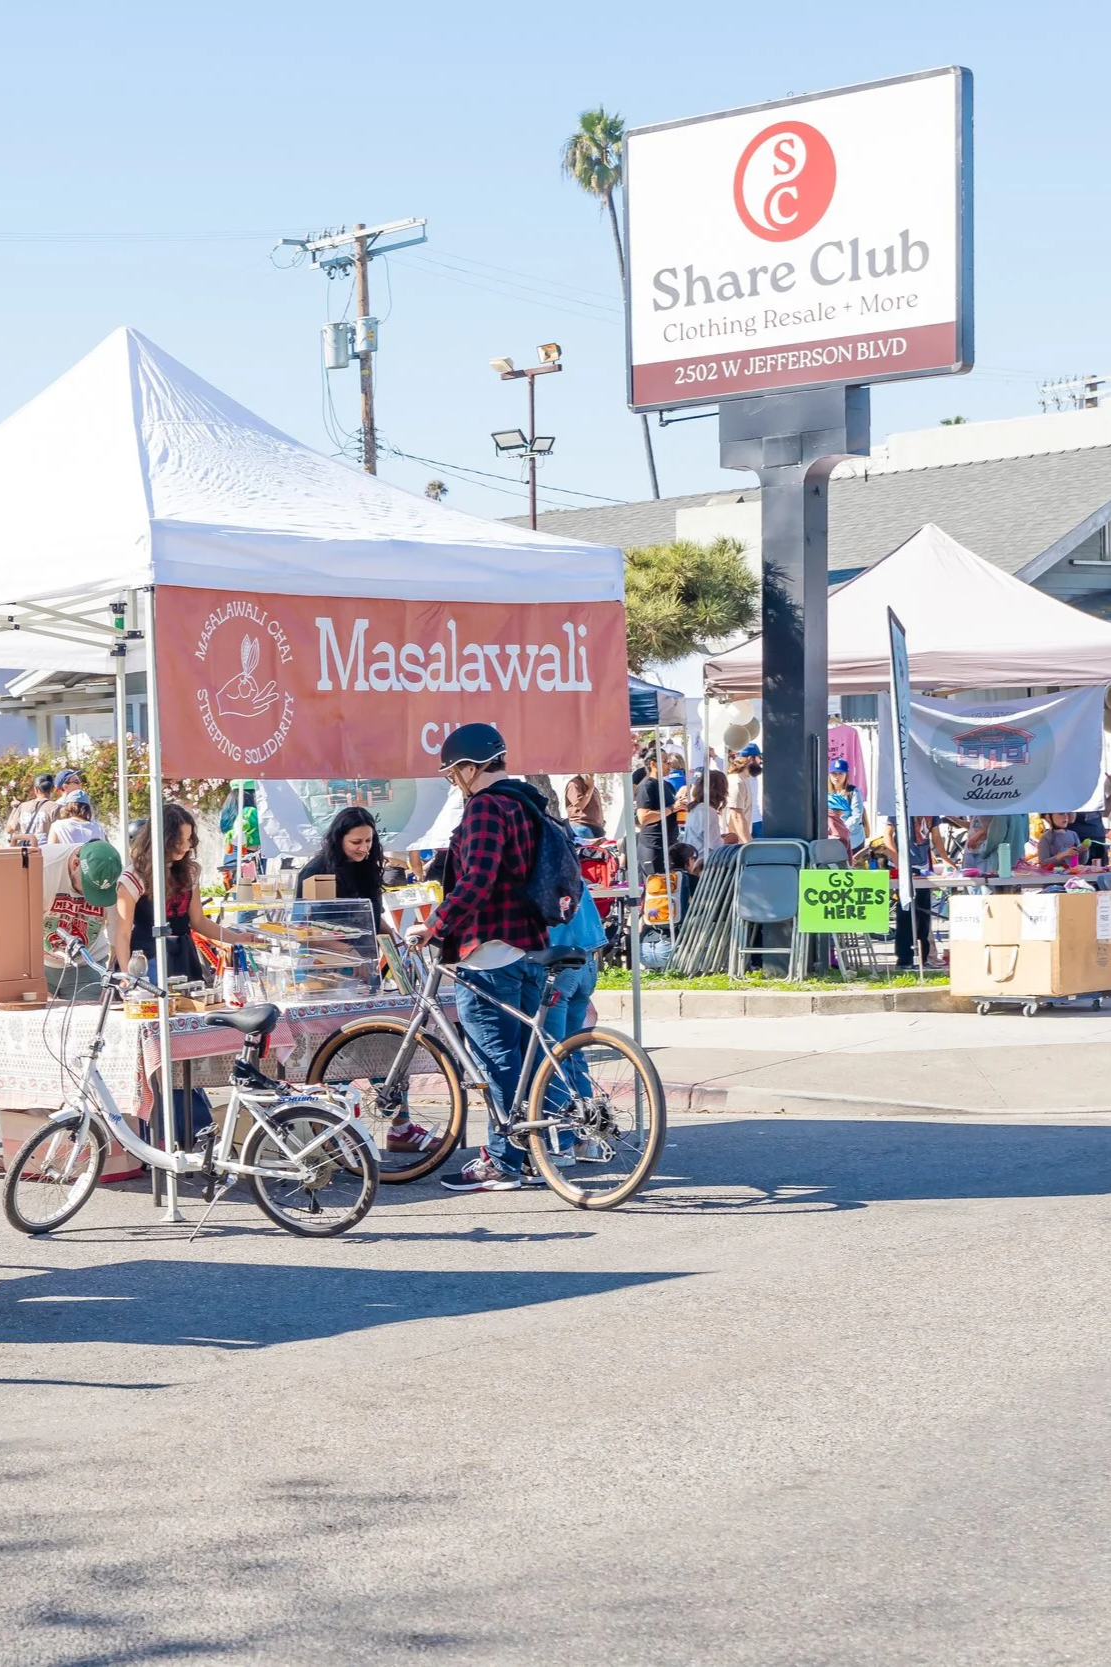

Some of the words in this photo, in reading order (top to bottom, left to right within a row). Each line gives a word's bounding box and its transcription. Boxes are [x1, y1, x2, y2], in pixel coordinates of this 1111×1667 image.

[773, 138, 796, 176] S
[769, 186, 798, 225] C
[653, 262, 796, 312] Share
[810, 229, 930, 285] Club
[663, 316, 757, 343] Clothing
[763, 302, 836, 329] Resale
[860, 293, 918, 315] More
[674, 362, 718, 385] 2502
[721, 359, 742, 378] W
[744, 344, 852, 376] JEFFERSON
[857, 337, 907, 361] BLVD
[194, 601, 268, 661] MASALAWALI
[267, 620, 293, 664] CHAI
[315, 616, 592, 692] Masalawali
[197, 688, 242, 761] STEEPING
[244, 691, 294, 764] SOLIDARITY
[962, 787, 1022, 800] Adams
[971, 773, 1014, 787] West
[804, 887, 887, 906] COOKIES
[829, 871, 854, 887] GS
[824, 905, 867, 920] HERE
